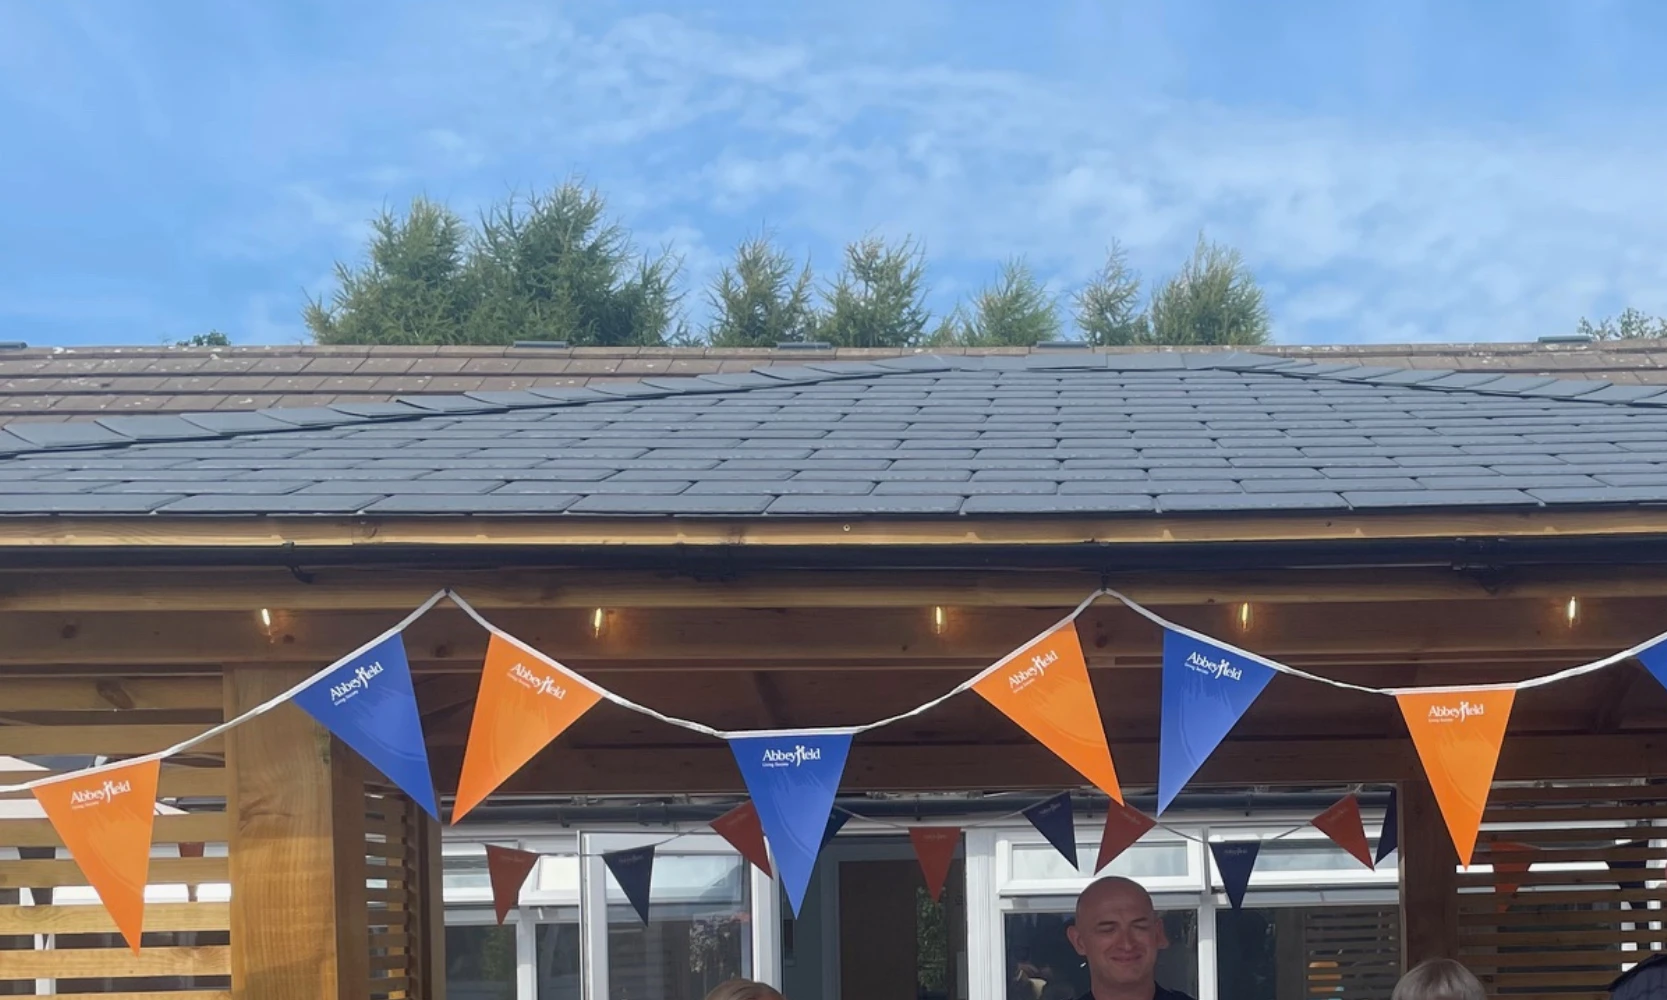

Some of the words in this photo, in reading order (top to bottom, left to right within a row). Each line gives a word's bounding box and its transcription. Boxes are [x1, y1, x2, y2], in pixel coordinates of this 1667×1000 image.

[329, 661, 384, 701] Abbeyfield
[1186, 651, 1243, 681] Abbeyfield
[761, 744, 821, 767] Abbeyfield
